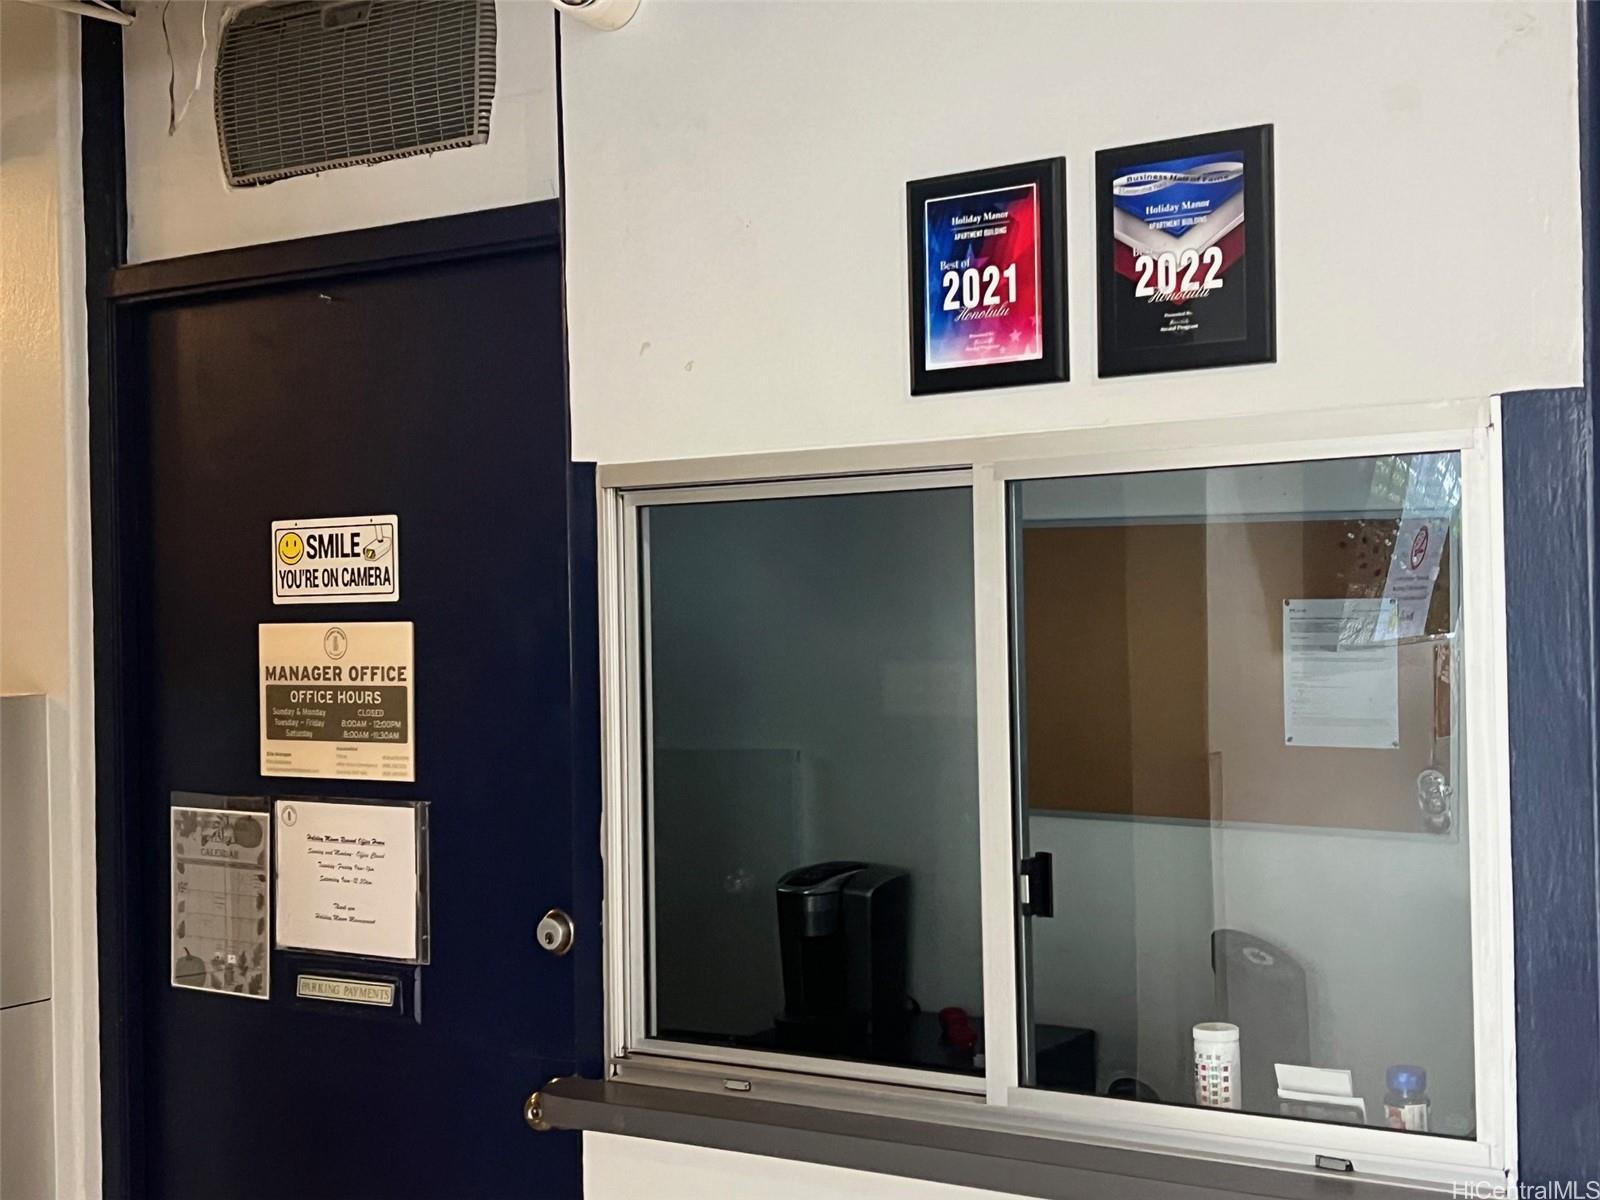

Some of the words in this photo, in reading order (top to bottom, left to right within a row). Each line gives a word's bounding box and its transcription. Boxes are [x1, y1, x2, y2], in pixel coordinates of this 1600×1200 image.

[1127, 173, 1168, 183] Business
[1145, 204, 1179, 215] Holiday
[1182, 200, 1210, 210] Manor
[951, 214, 981, 226] Holiday
[983, 211, 1009, 221] Manor
[954, 230, 983, 240] APARTMENT
[940, 260, 959, 271] Best
[960, 257, 970, 268] of
[1135, 246, 1224, 298] 2022
[942, 263, 1017, 311] 2021
[1148, 285, 1211, 304] Honolulu
[954, 301, 1010, 322] Honolulu
[306, 532, 361, 560] SMILE
[279, 568, 319, 590] YOU'RE
[321, 567, 339, 588] ON
[341, 566, 392, 588] CAMERA
[265, 665, 343, 682] MANAGER
[348, 665, 407, 682] OFFICE
[290, 690, 334, 704] OFFICE
[337, 690, 382, 705] HOURS
[272, 707, 295, 717] Sunday
[296, 708, 301, 716] &
[302, 708, 326, 718] Monday
[357, 709, 384, 717] CLOSED
[274, 718, 299, 728] Tuesday
[306, 718, 325, 728] Friday
[301, 981, 340, 995] PARKING
[343, 985, 390, 1000] PAYMENTS
